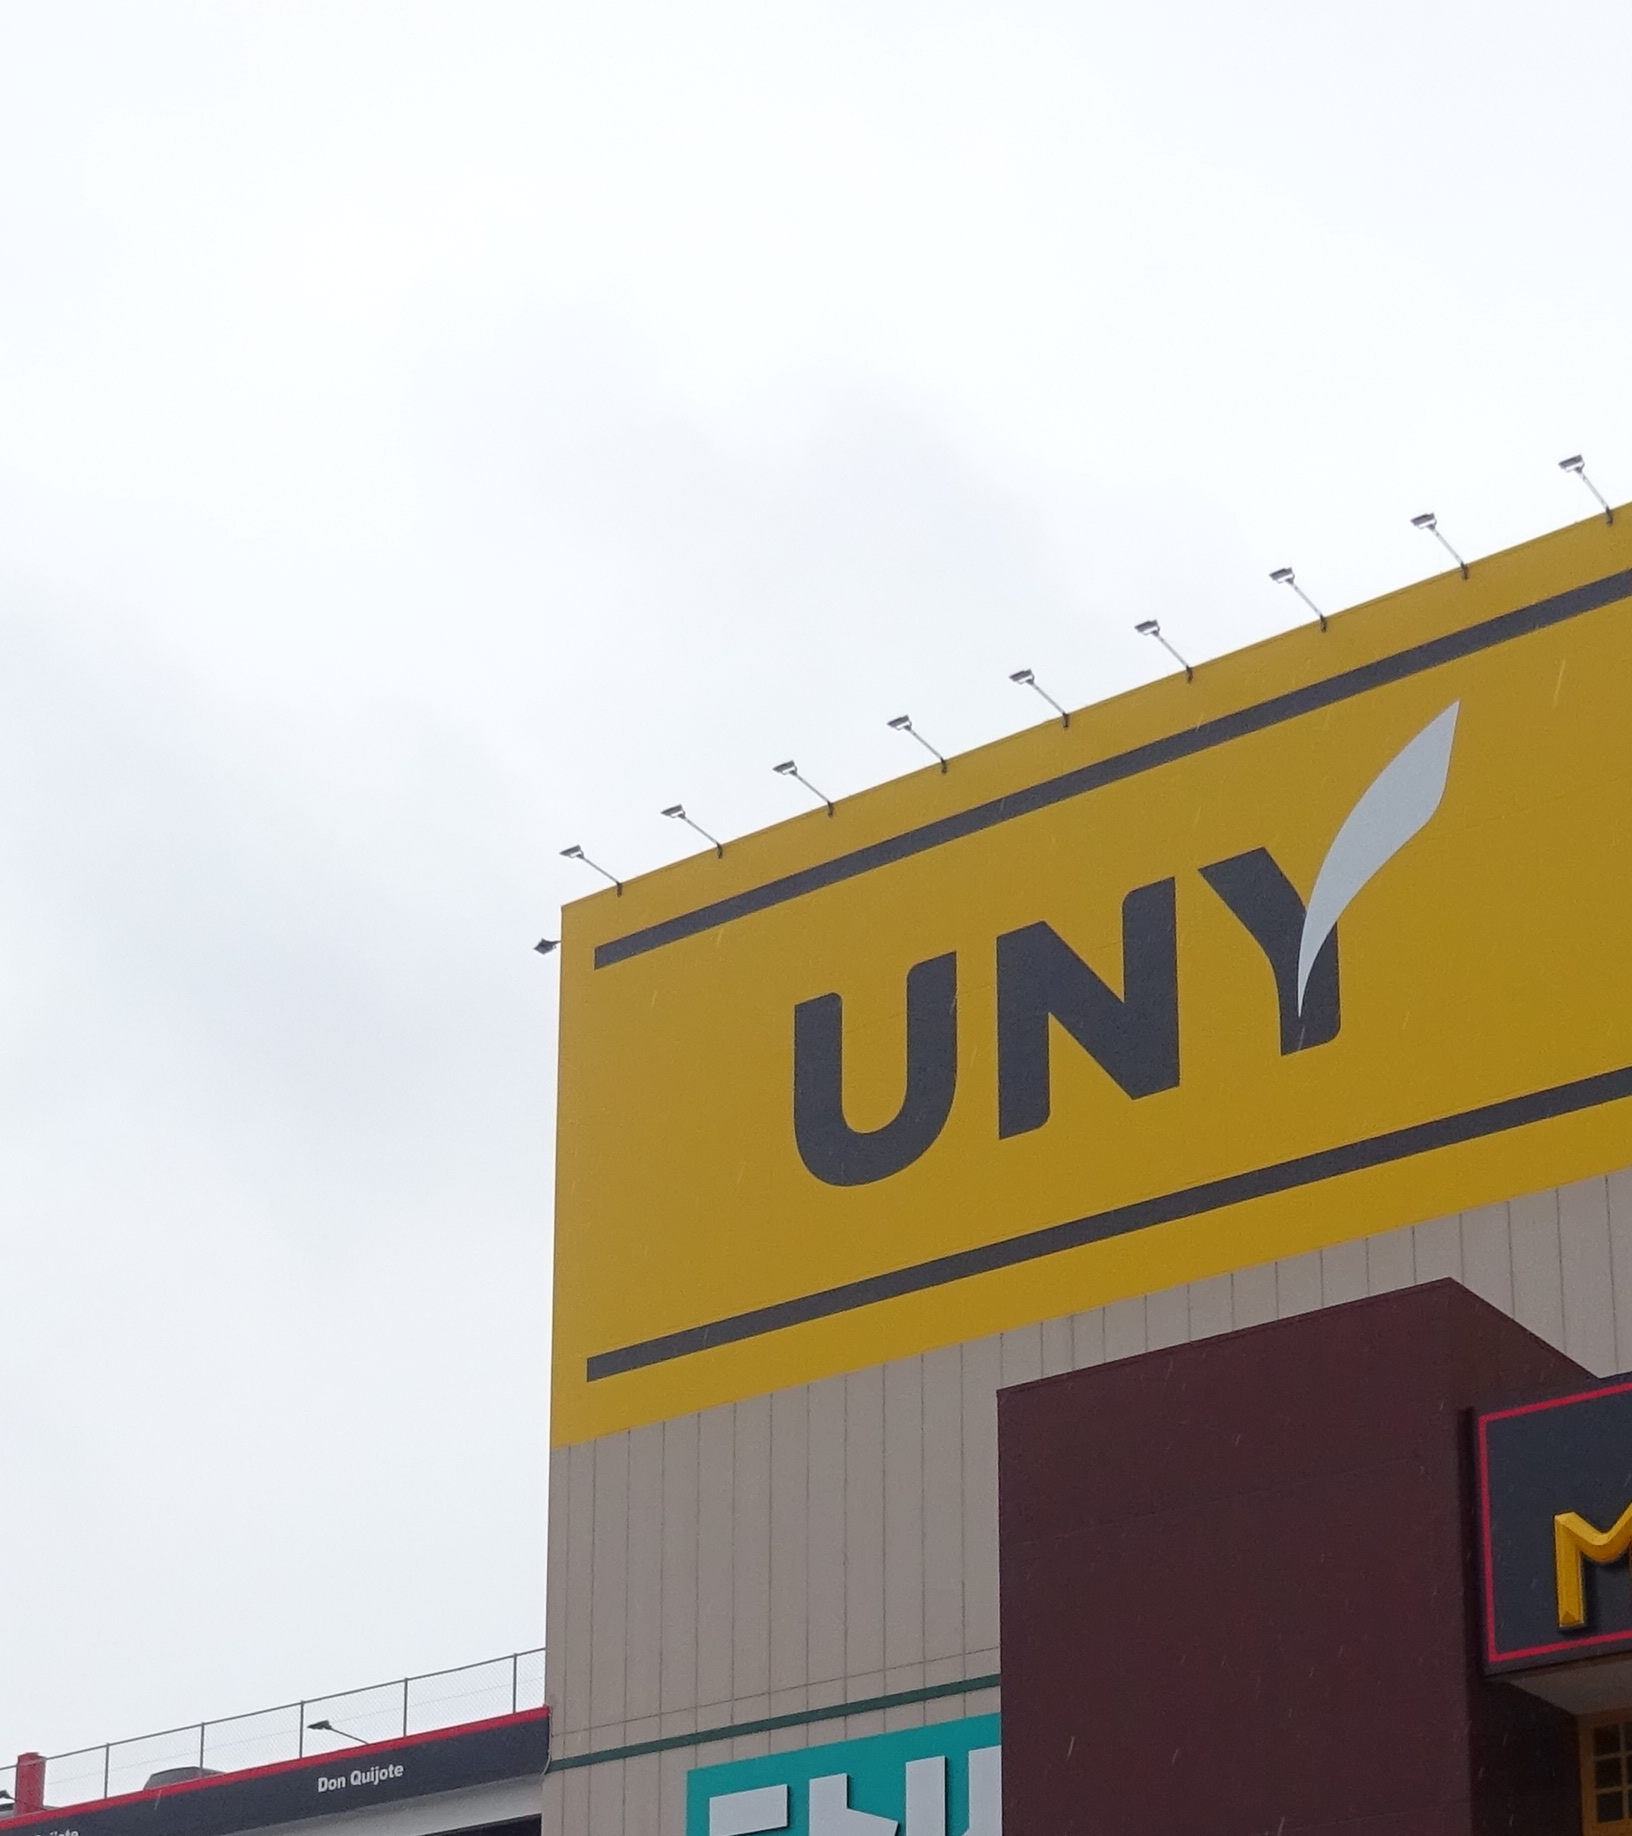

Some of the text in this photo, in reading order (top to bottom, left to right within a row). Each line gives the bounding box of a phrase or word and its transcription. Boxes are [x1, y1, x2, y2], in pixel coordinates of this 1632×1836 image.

[793, 700, 1459, 1187] UNY
[318, 1763, 404, 1793] Don Quijote
